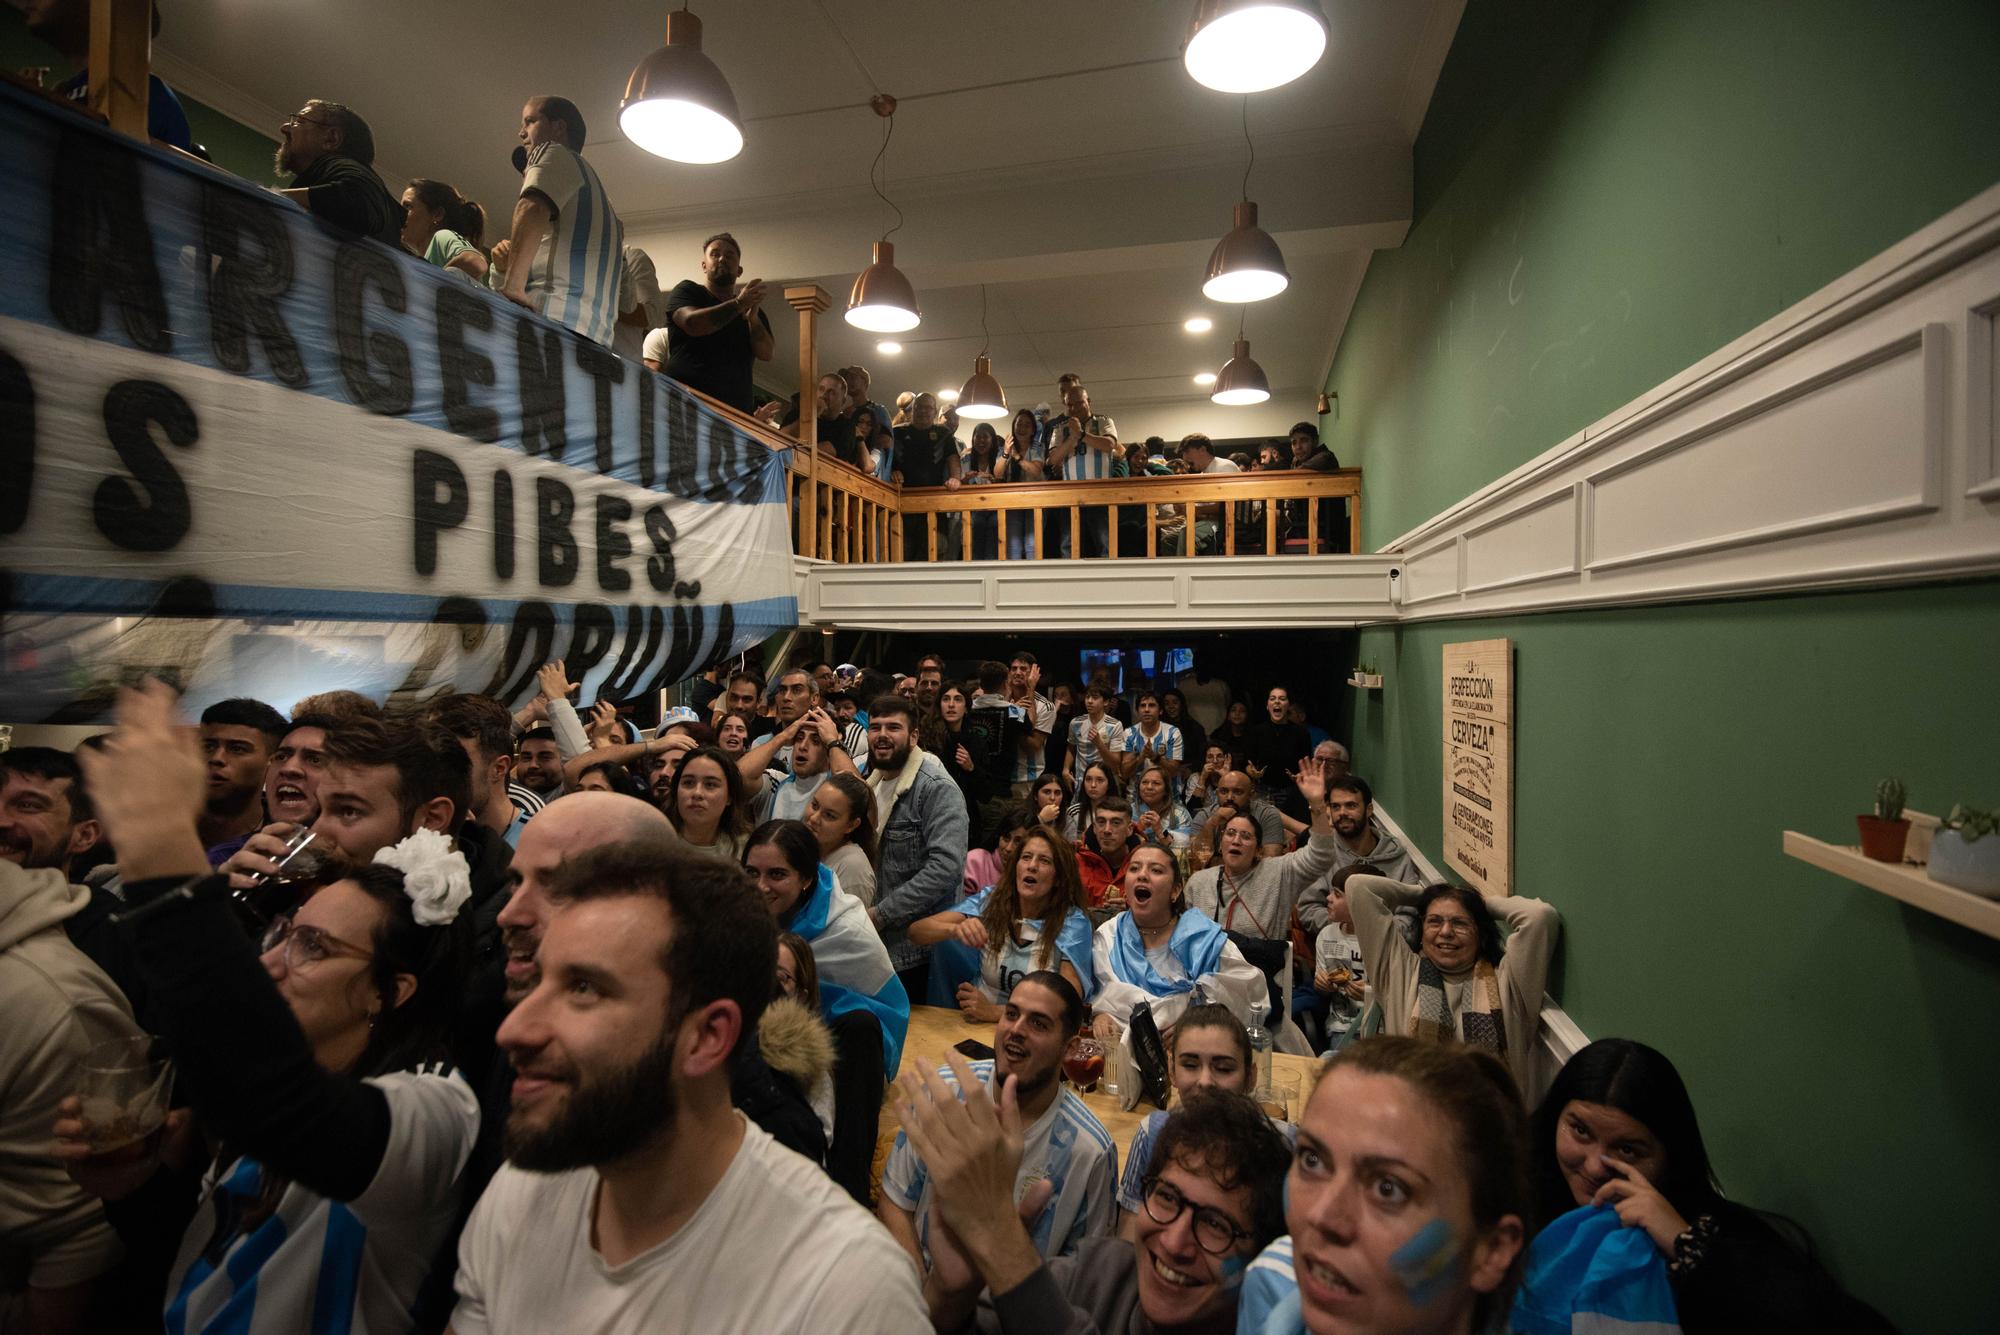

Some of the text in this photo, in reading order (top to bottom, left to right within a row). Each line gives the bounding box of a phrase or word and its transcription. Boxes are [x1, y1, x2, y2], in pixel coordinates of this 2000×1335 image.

[413, 449, 677, 591] PIBES
[1451, 672, 1493, 699] PERFECCIÓN
[1452, 719, 1488, 752] CERVEZA
[1452, 801, 1493, 835] 4 GENERACIONES
[1467, 822, 1480, 840] FAMILIA
[1480, 830, 1493, 848] RIVERA
